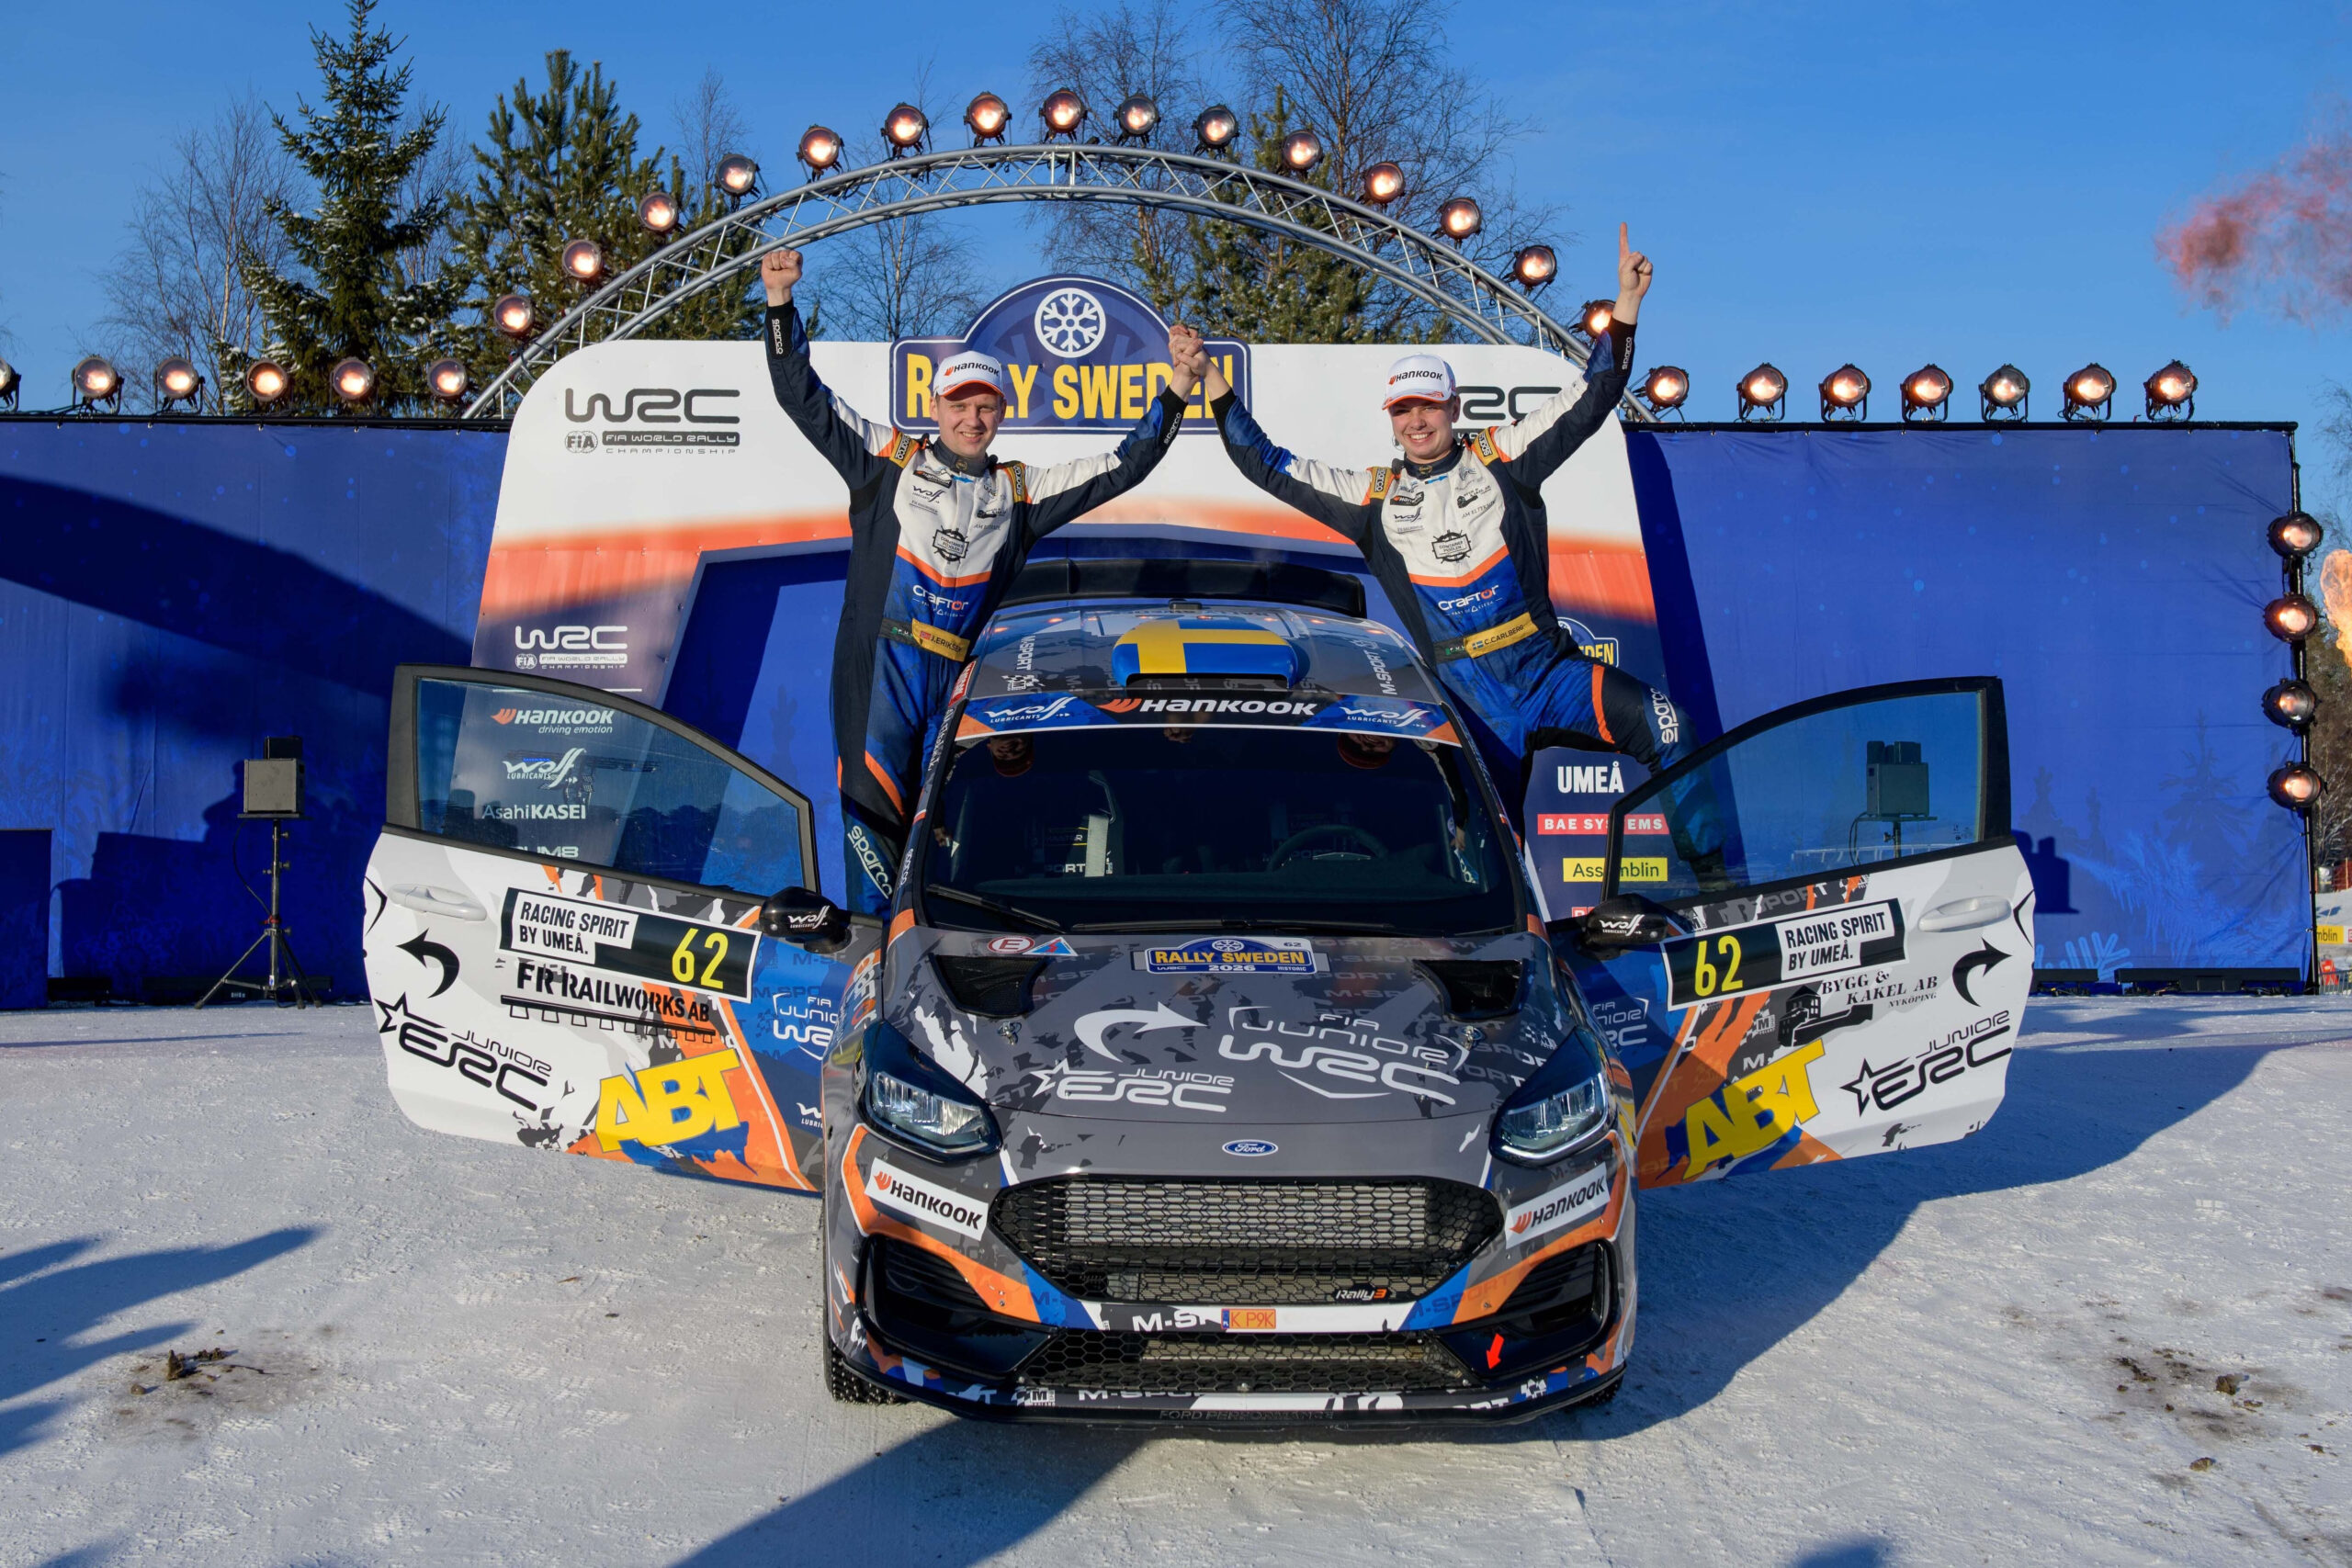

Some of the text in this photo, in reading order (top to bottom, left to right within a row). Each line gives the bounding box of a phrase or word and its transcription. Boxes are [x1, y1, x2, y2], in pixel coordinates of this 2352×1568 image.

[565, 388, 741, 423] WRC
[1456, 386, 1563, 421] RC
[686, 434, 737, 443] RALLY
[515, 626, 628, 650] WRC
[538, 725, 613, 735] driving emotion
[1347, 716, 1397, 725] LUBRICANTS
[1557, 761, 1624, 793] UMEÅ
[1544, 818, 1663, 830] BAE SYEMS
[847, 825, 892, 900] sparco
[1573, 862, 1659, 878] Assmblin
[520, 901, 629, 939] RACING SPIRIT
[1785, 912, 1885, 949] RACING SPIRIT
[520, 925, 589, 954] BY UMEÅ.
[1788, 939, 1853, 971] BY UMEÅ.
[672, 927, 729, 989] 62
[1155, 951, 1305, 964] RALLY SWEDEN
[1695, 934, 1744, 998] 62
[517, 962, 709, 1022] FR RAILWORKS AB
[1821, 969, 1890, 995] BYGG &
[1846, 976, 1939, 1006] KAKEL AB
[808, 997, 831, 1008] FIA
[1592, 1001, 1615, 1011] FIA
[1888, 990, 1938, 1008] NYKÖPING
[780, 1008, 839, 1024] JUNIO
[1319, 1013, 1380, 1031] FIA
[774, 1020, 834, 1046] WR
[1241, 1020, 1450, 1066] JUNIOR
[1916, 1010, 2010, 1059] JUNIOR
[399, 1021, 548, 1112] ERC
[451, 1030, 552, 1077] JUNIOR
[1871, 1024, 2012, 1111] ERC
[1118, 1067, 1236, 1087] JUNIOR
[1218, 1034, 1461, 1106] WRC
[595, 1047, 741, 1154] ABT
[1057, 1076, 1232, 1112] ERC
[1682, 1038, 1826, 1181] ABT
[1234, 1142, 1266, 1154] Ford
